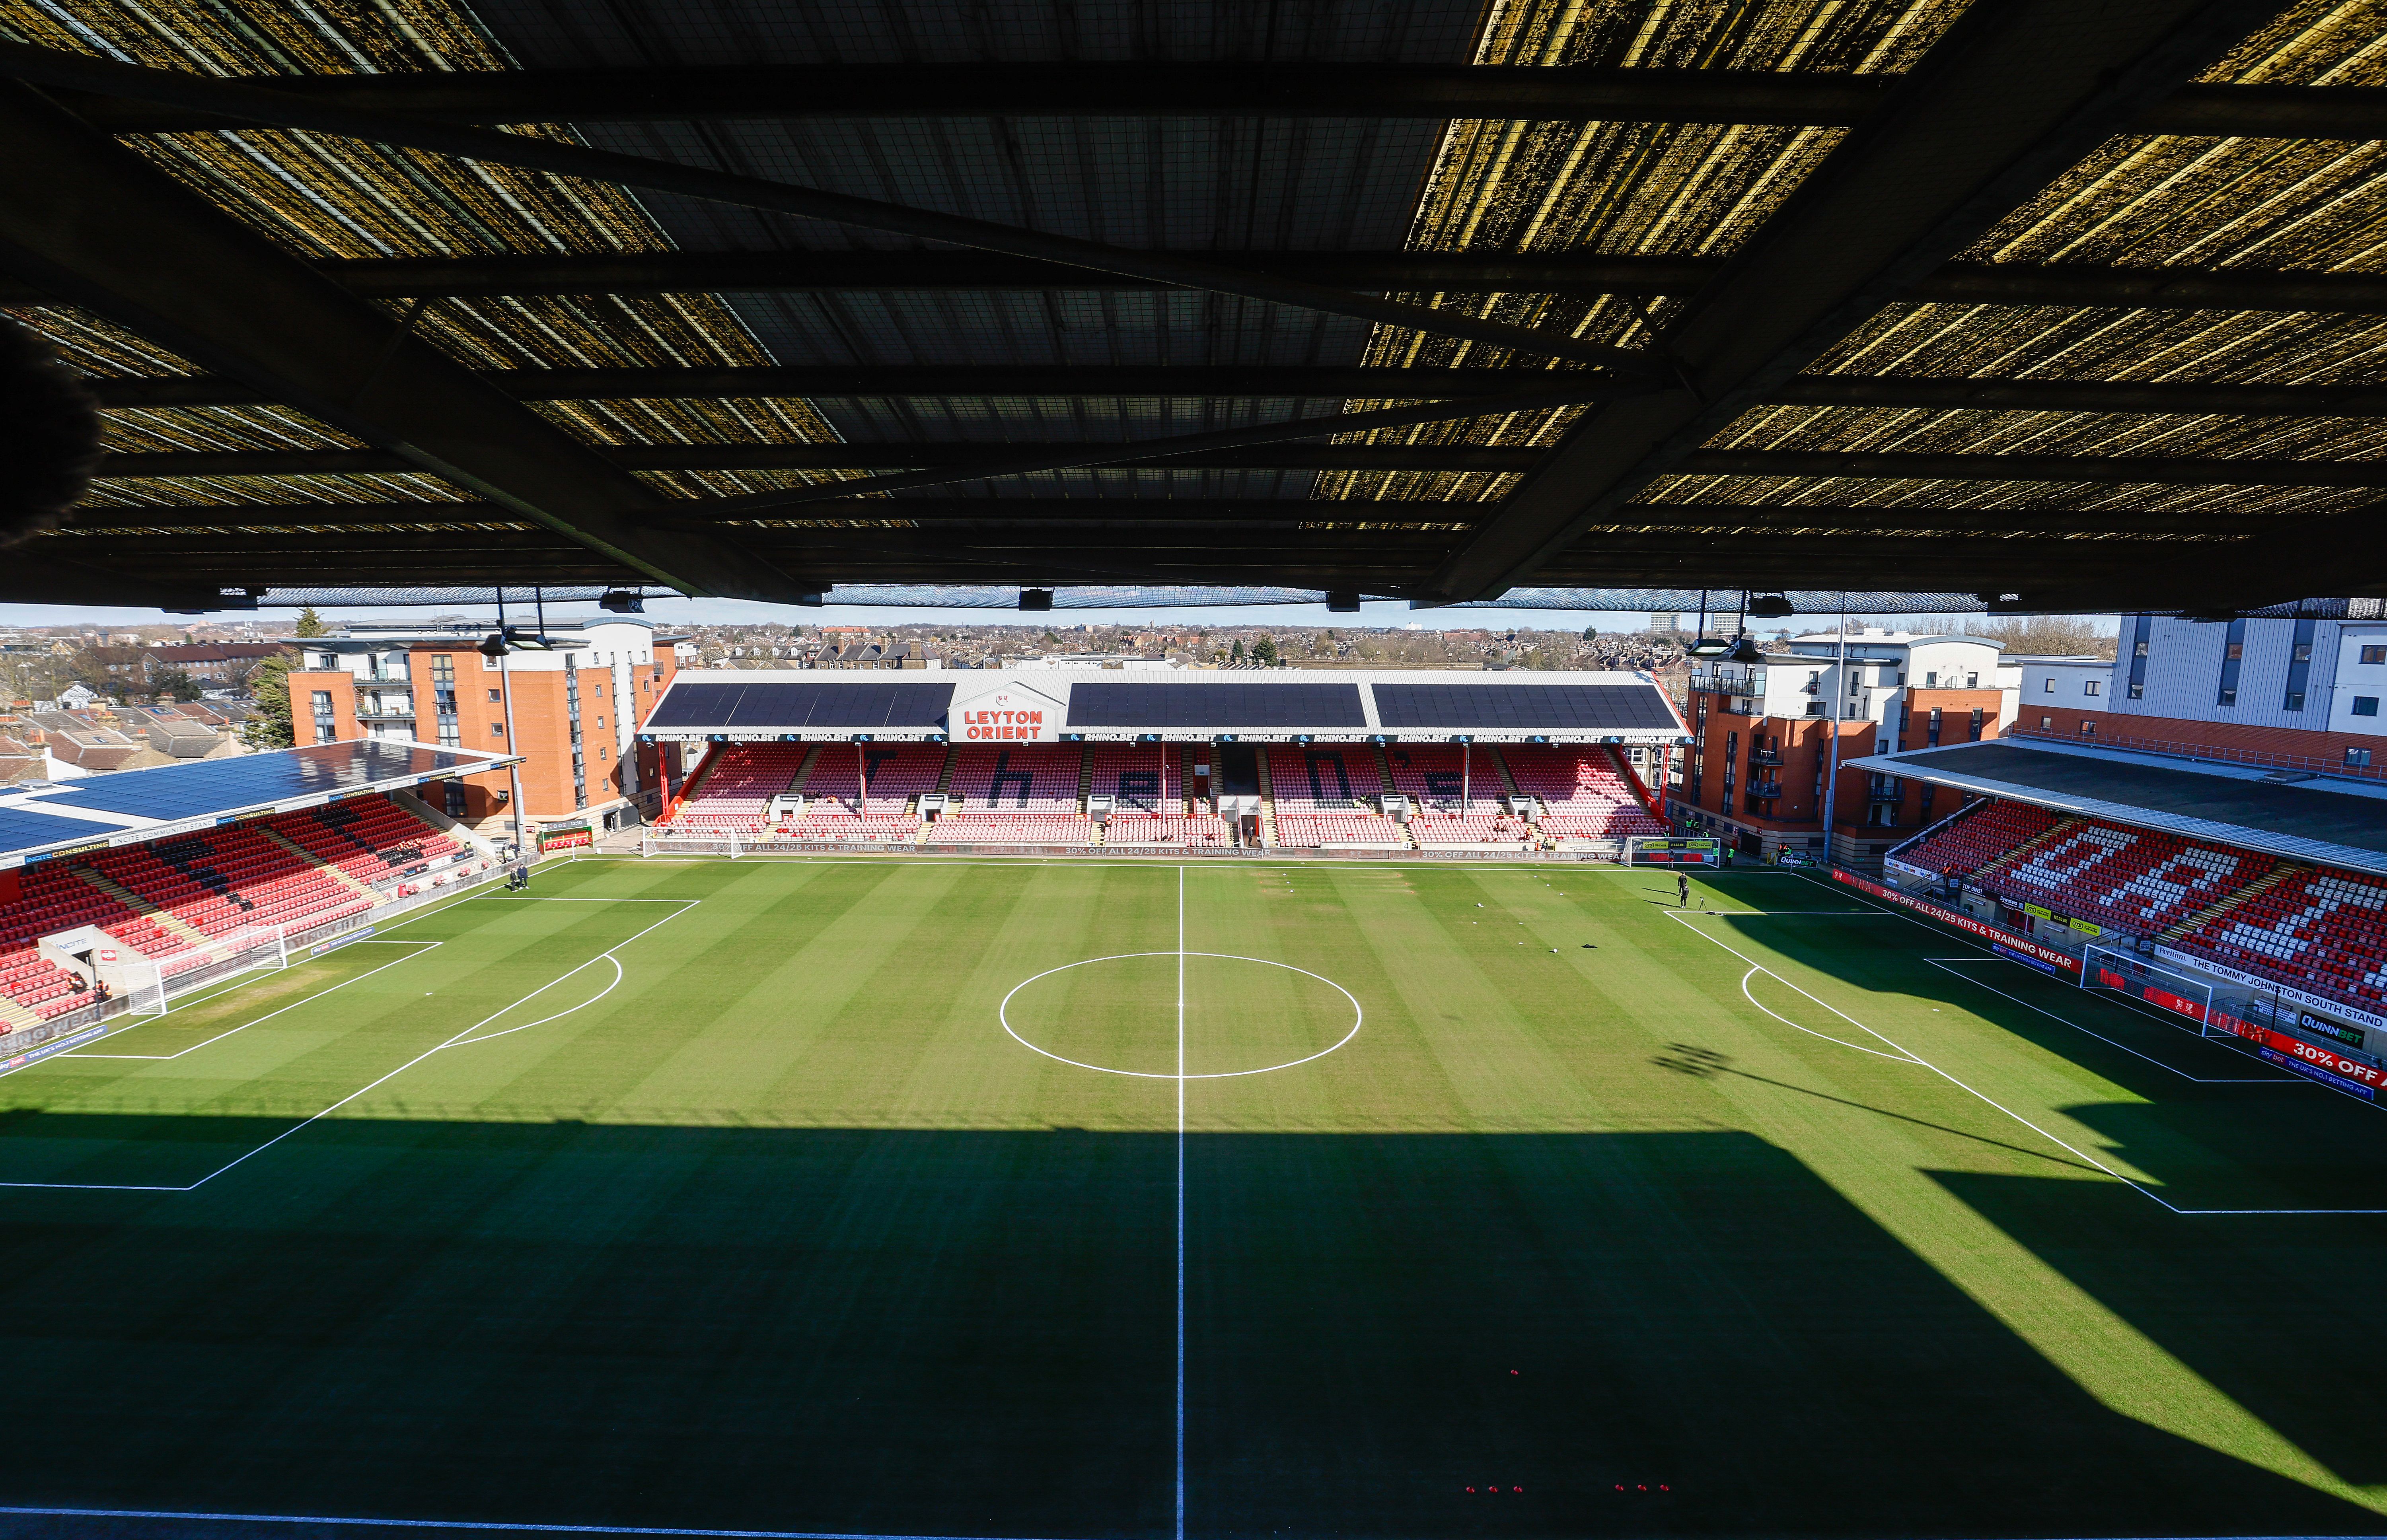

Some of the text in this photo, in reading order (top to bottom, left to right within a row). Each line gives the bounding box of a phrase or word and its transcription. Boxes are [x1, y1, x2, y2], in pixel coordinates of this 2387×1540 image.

[964, 711, 1042, 724] LEYTON
[967, 726, 1041, 739] ORIENT
[115, 820, 212, 844] INCITE COMMUNITY STAND
[774, 843, 802, 852] 24/25
[1127, 847, 1156, 856] 24/25
[1484, 851, 1512, 859] 24/25
[1781, 857, 1813, 866] QUINNBET
[2000, 896, 2018, 905] Bywaters
[1883, 890, 2072, 968] 30% OFF ALL 24/25 KITS & TRAINING WEAR
[2193, 959, 2210, 970] THE
[2212, 964, 2247, 981] TOMMY
[2248, 977, 2302, 1001] JOHNSTON
[2305, 995, 2342, 1014] SOUTH
[2344, 1009, 2383, 1027] STAND
[2301, 1015, 2362, 1043] QUINNBET
[11, 1057, 25, 1067] bet
[41, 1046, 55, 1055] UK'S
[70, 1032, 93, 1044] BETTING
[2294, 1043, 2378, 1081] 30% OFF
[2273, 1054, 2284, 1062] bet
[2300, 1065, 2313, 1074] UK'S
[2314, 1071, 2327, 1080] NO.1
[2329, 1076, 2354, 1090] BETTING
